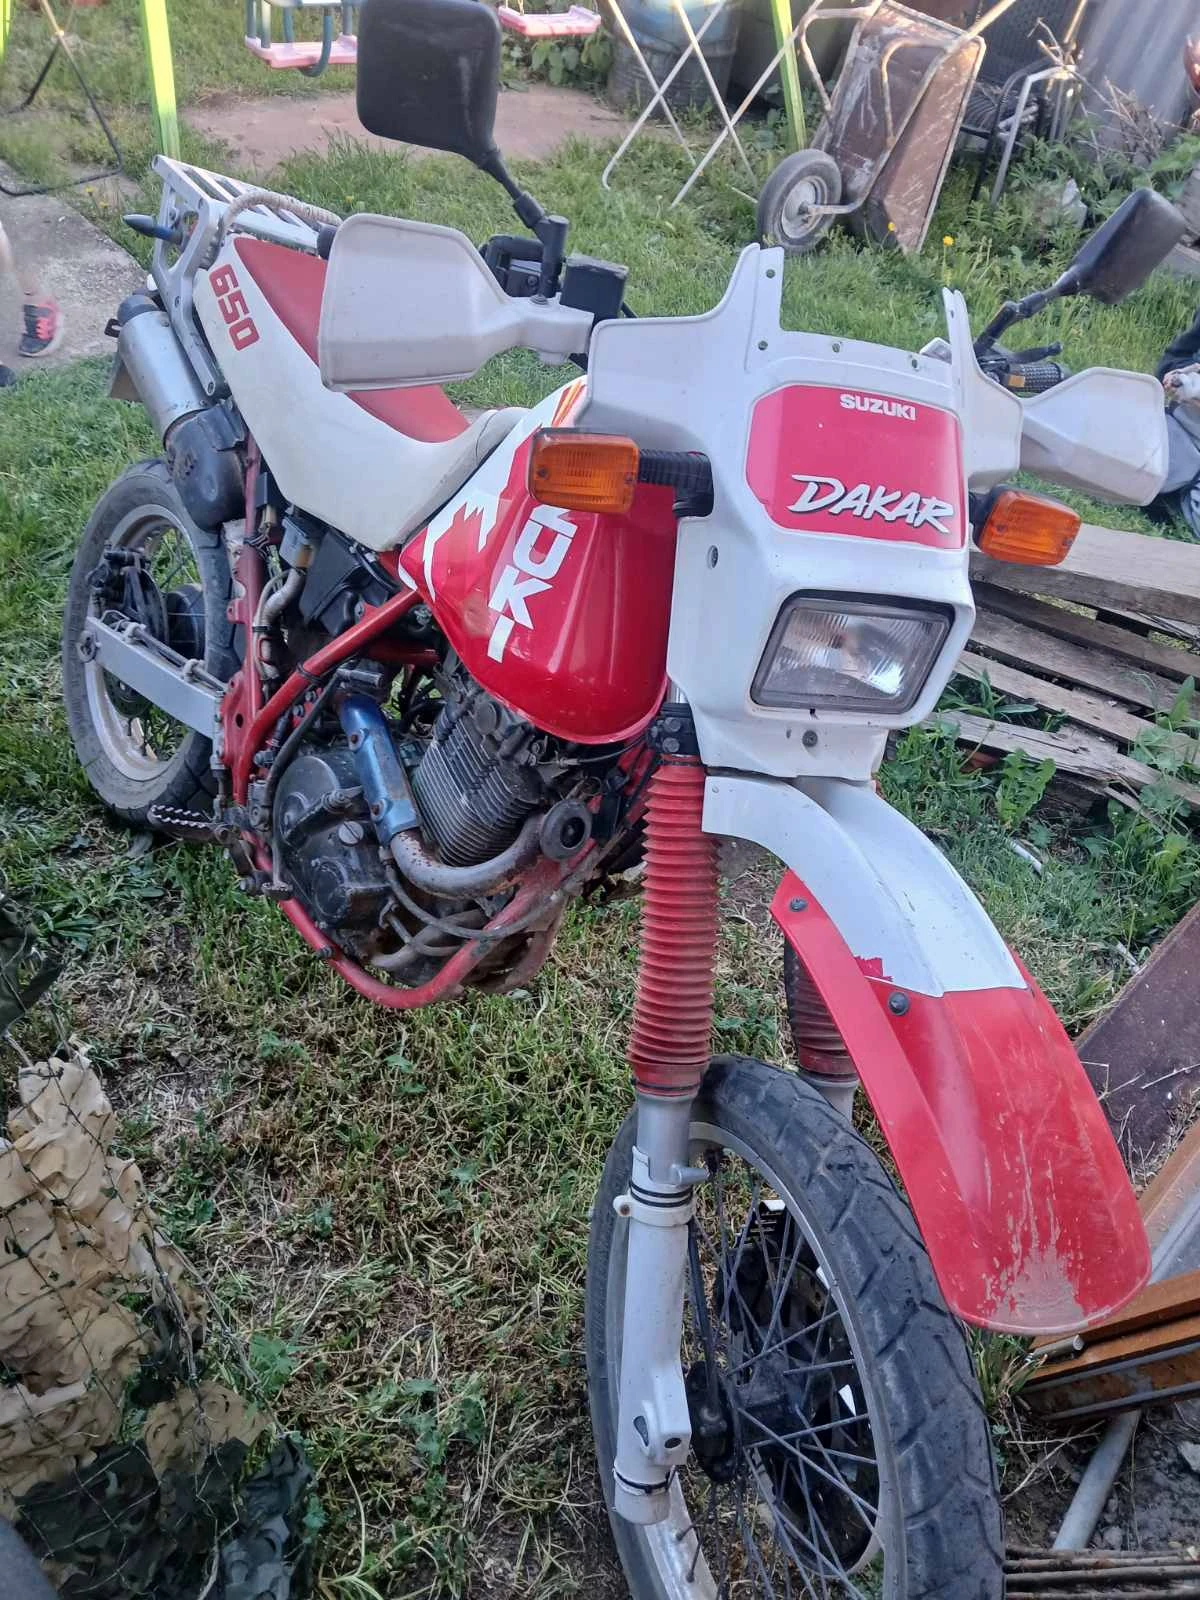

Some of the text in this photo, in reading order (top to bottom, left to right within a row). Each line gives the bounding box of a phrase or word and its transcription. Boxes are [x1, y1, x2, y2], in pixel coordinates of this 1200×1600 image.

[209, 264, 260, 351] 650
[839, 393, 916, 421] SUZUKI
[786, 473, 954, 534] DAKAR
